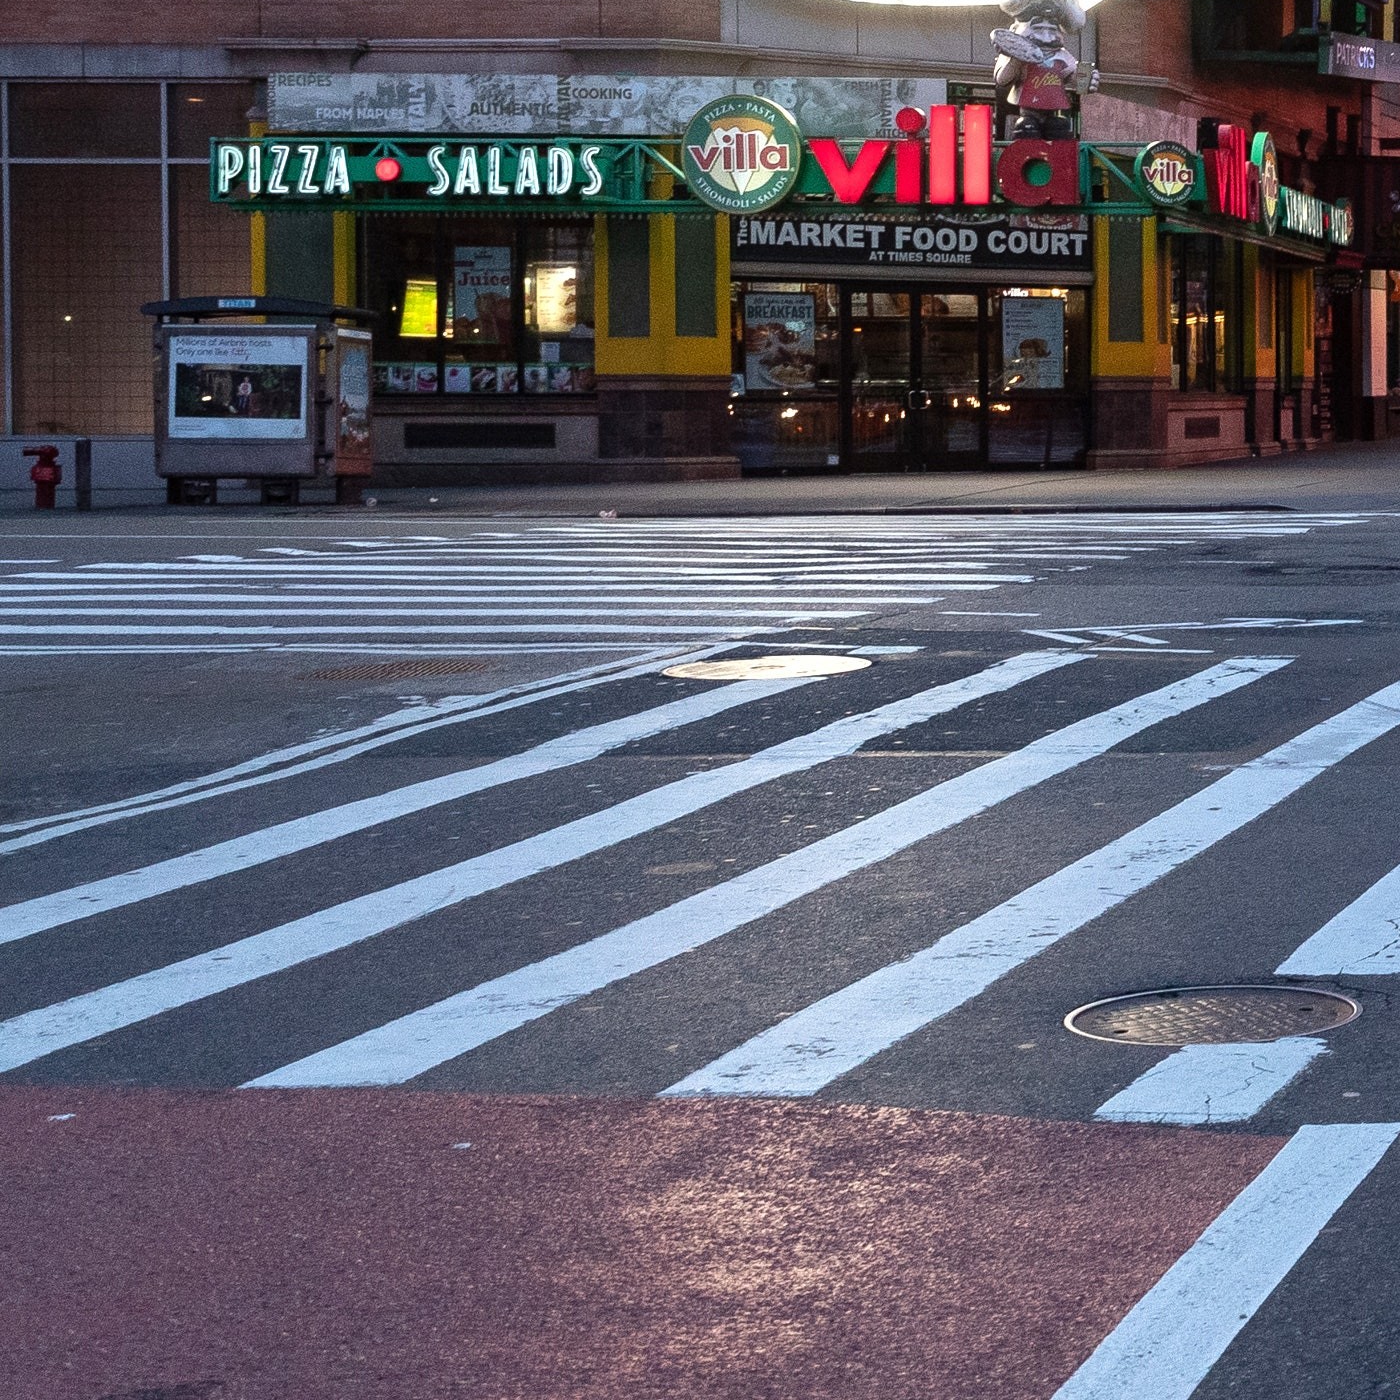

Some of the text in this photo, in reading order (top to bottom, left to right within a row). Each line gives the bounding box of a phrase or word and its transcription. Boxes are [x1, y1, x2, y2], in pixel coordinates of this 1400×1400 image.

[572, 86, 633, 101] COOKING
[704, 101, 777, 124] PIZZA PASTA
[687, 132, 791, 174] villa
[807, 104, 1082, 205] villa
[217, 145, 604, 196] PIZZA SALADS
[1142, 161, 1195, 185] villa
[695, 175, 790, 209] STROMBOLI SALADS
[737, 219, 1088, 257] The MARKET FOOD COURT
[868, 250, 972, 266] AT TIMES SQUARE
[458, 270, 511, 287] Juice
[747, 304, 813, 320] BREAKFAST
